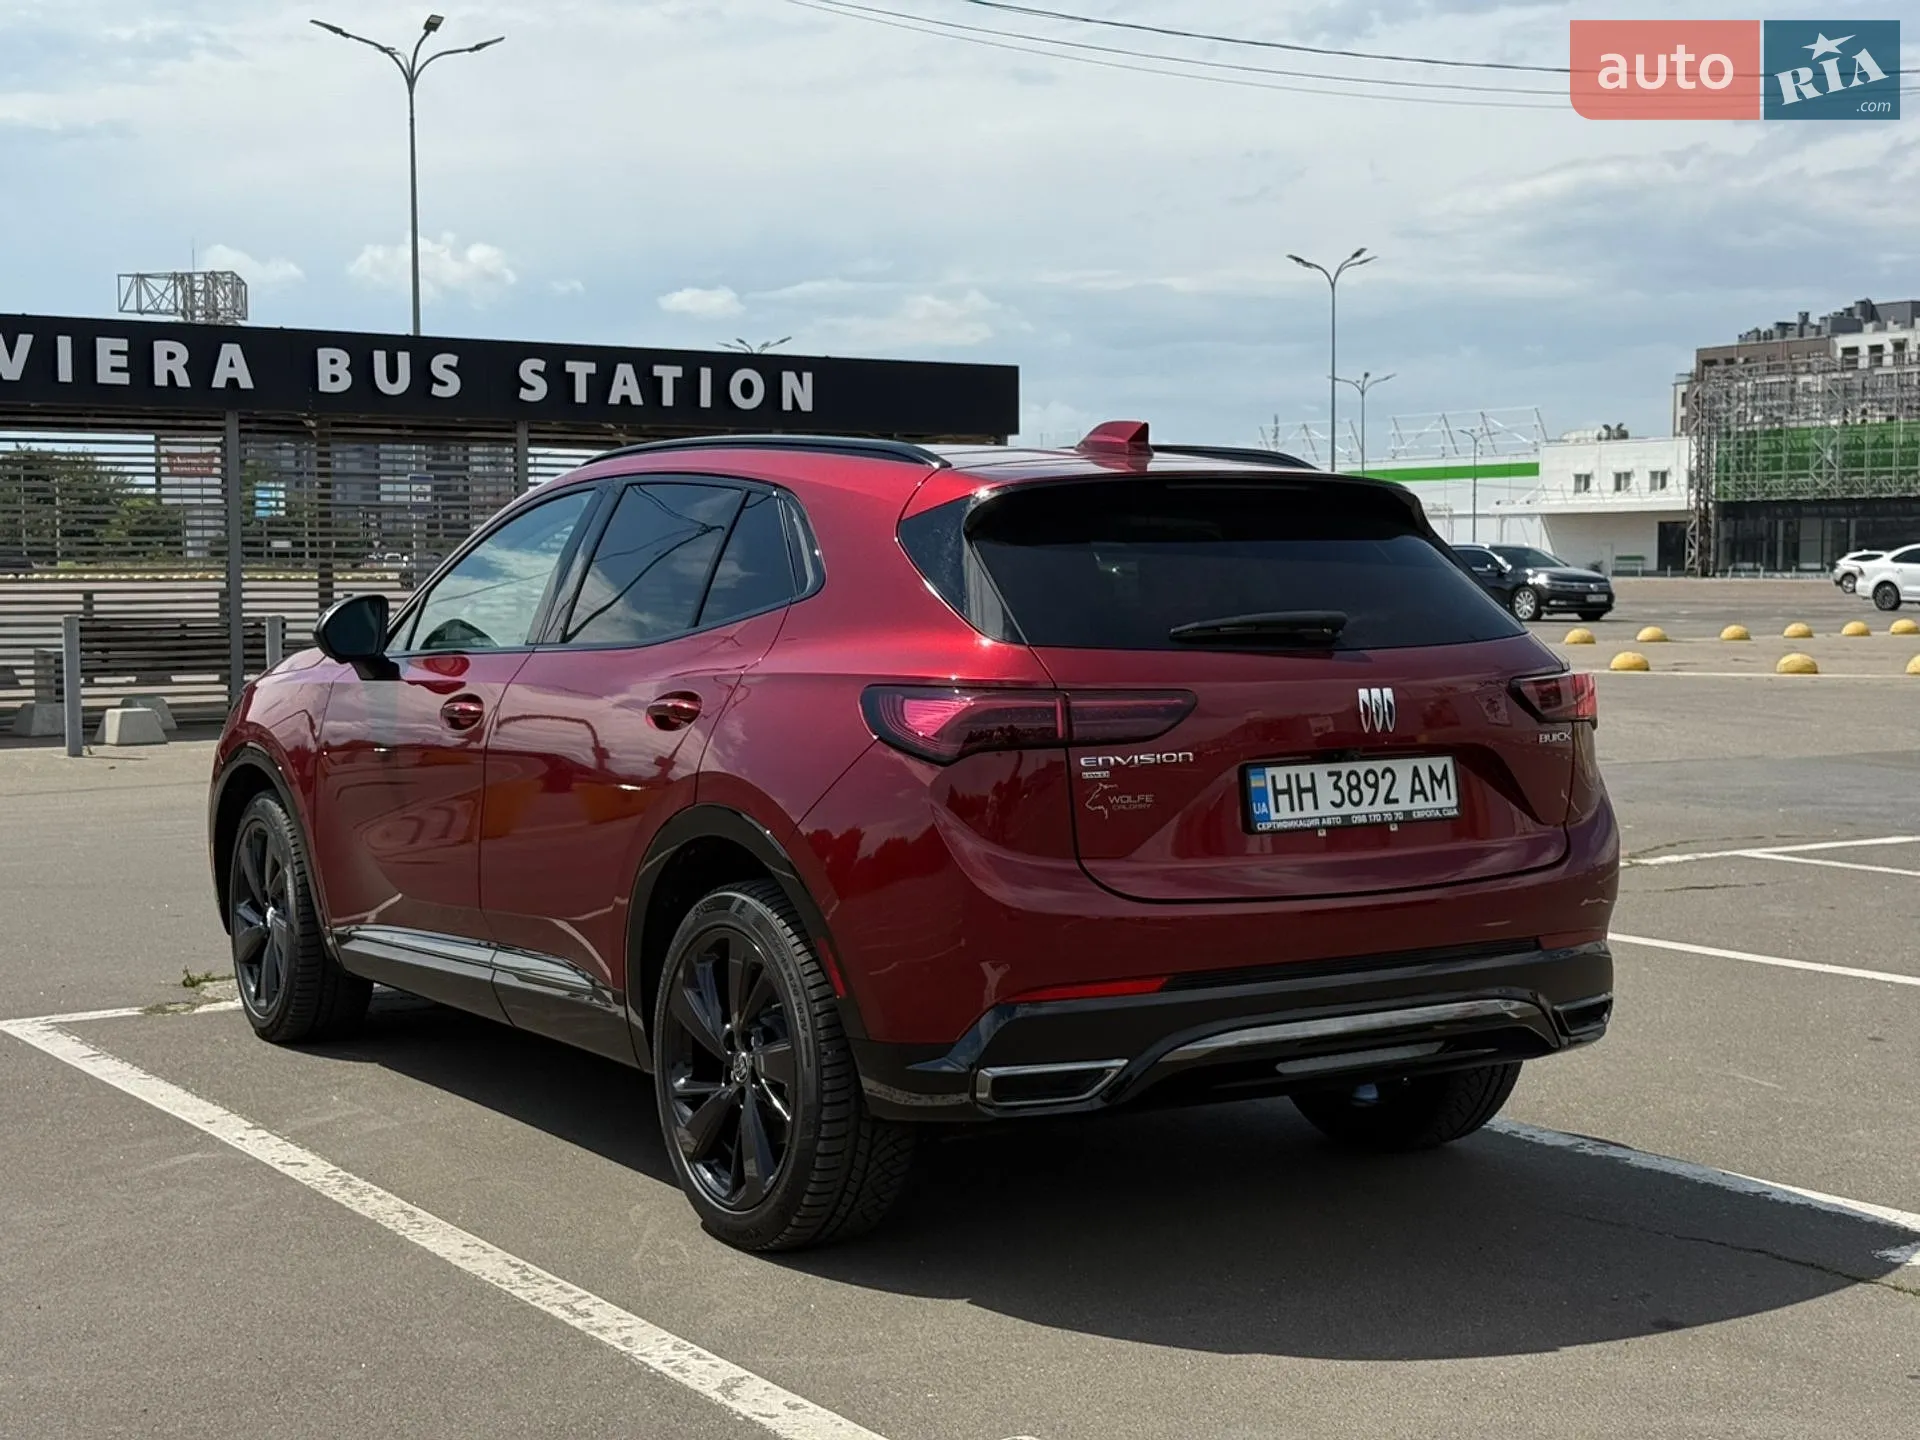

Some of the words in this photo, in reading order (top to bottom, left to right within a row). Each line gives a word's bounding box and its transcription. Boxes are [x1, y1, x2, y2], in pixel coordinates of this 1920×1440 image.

[317, 347, 462, 398] BUS
[518, 357, 814, 412] STATION
[1539, 730, 1572, 744] BUICK
[1080, 750, 1194, 767] ENVISION
[1271, 772, 1319, 813] HH
[1327, 766, 1400, 809] 3892
[1409, 763, 1452, 804] AM
[1108, 794, 1154, 804] WOLFE
[1253, 802, 1268, 815] UA
[1256, 818, 1320, 830] СЕРТИФИКАЦИЯ
[1321, 816, 1342, 826] АВТО
